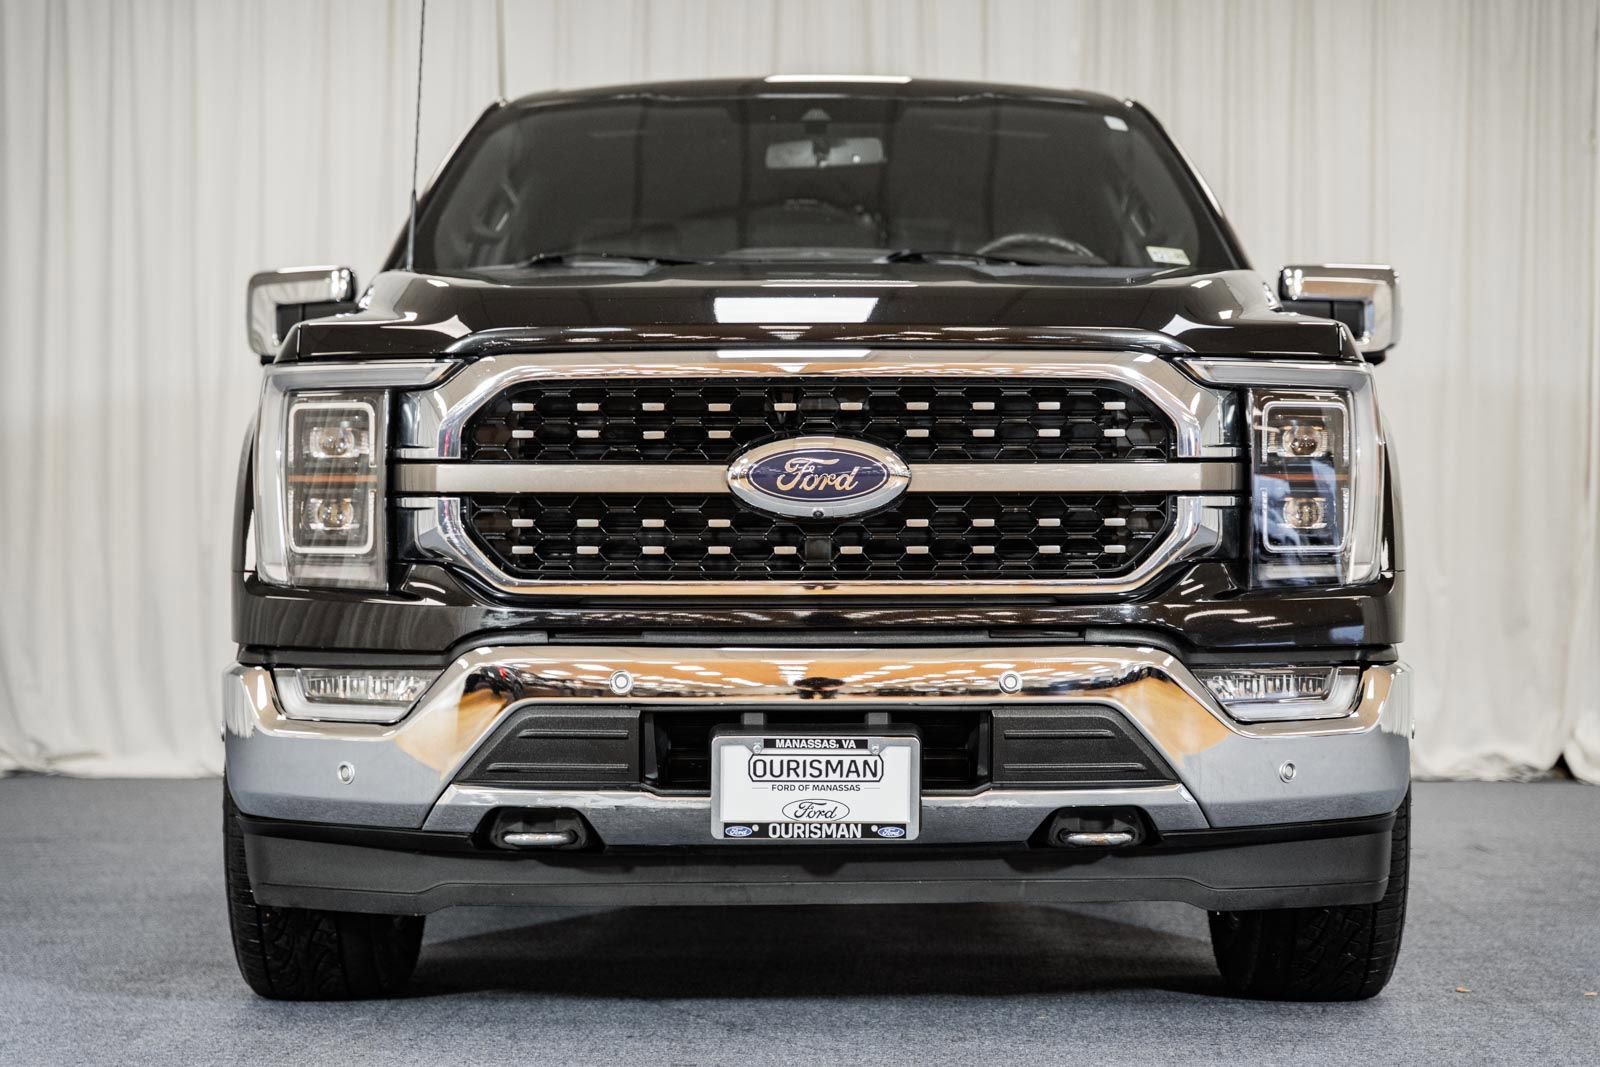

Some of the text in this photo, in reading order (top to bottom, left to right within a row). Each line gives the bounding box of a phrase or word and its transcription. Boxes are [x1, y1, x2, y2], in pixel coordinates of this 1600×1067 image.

[776, 457, 859, 491] Ford
[842, 739, 856, 749] VA
[752, 758, 878, 779] OURISMAN
[771, 784, 861, 792] FORD OF MANASSAS
[793, 801, 839, 820] Ford
[729, 827, 748, 836] Ford
[768, 823, 862, 839] OURISMAN
[882, 828, 900, 836] Ford
